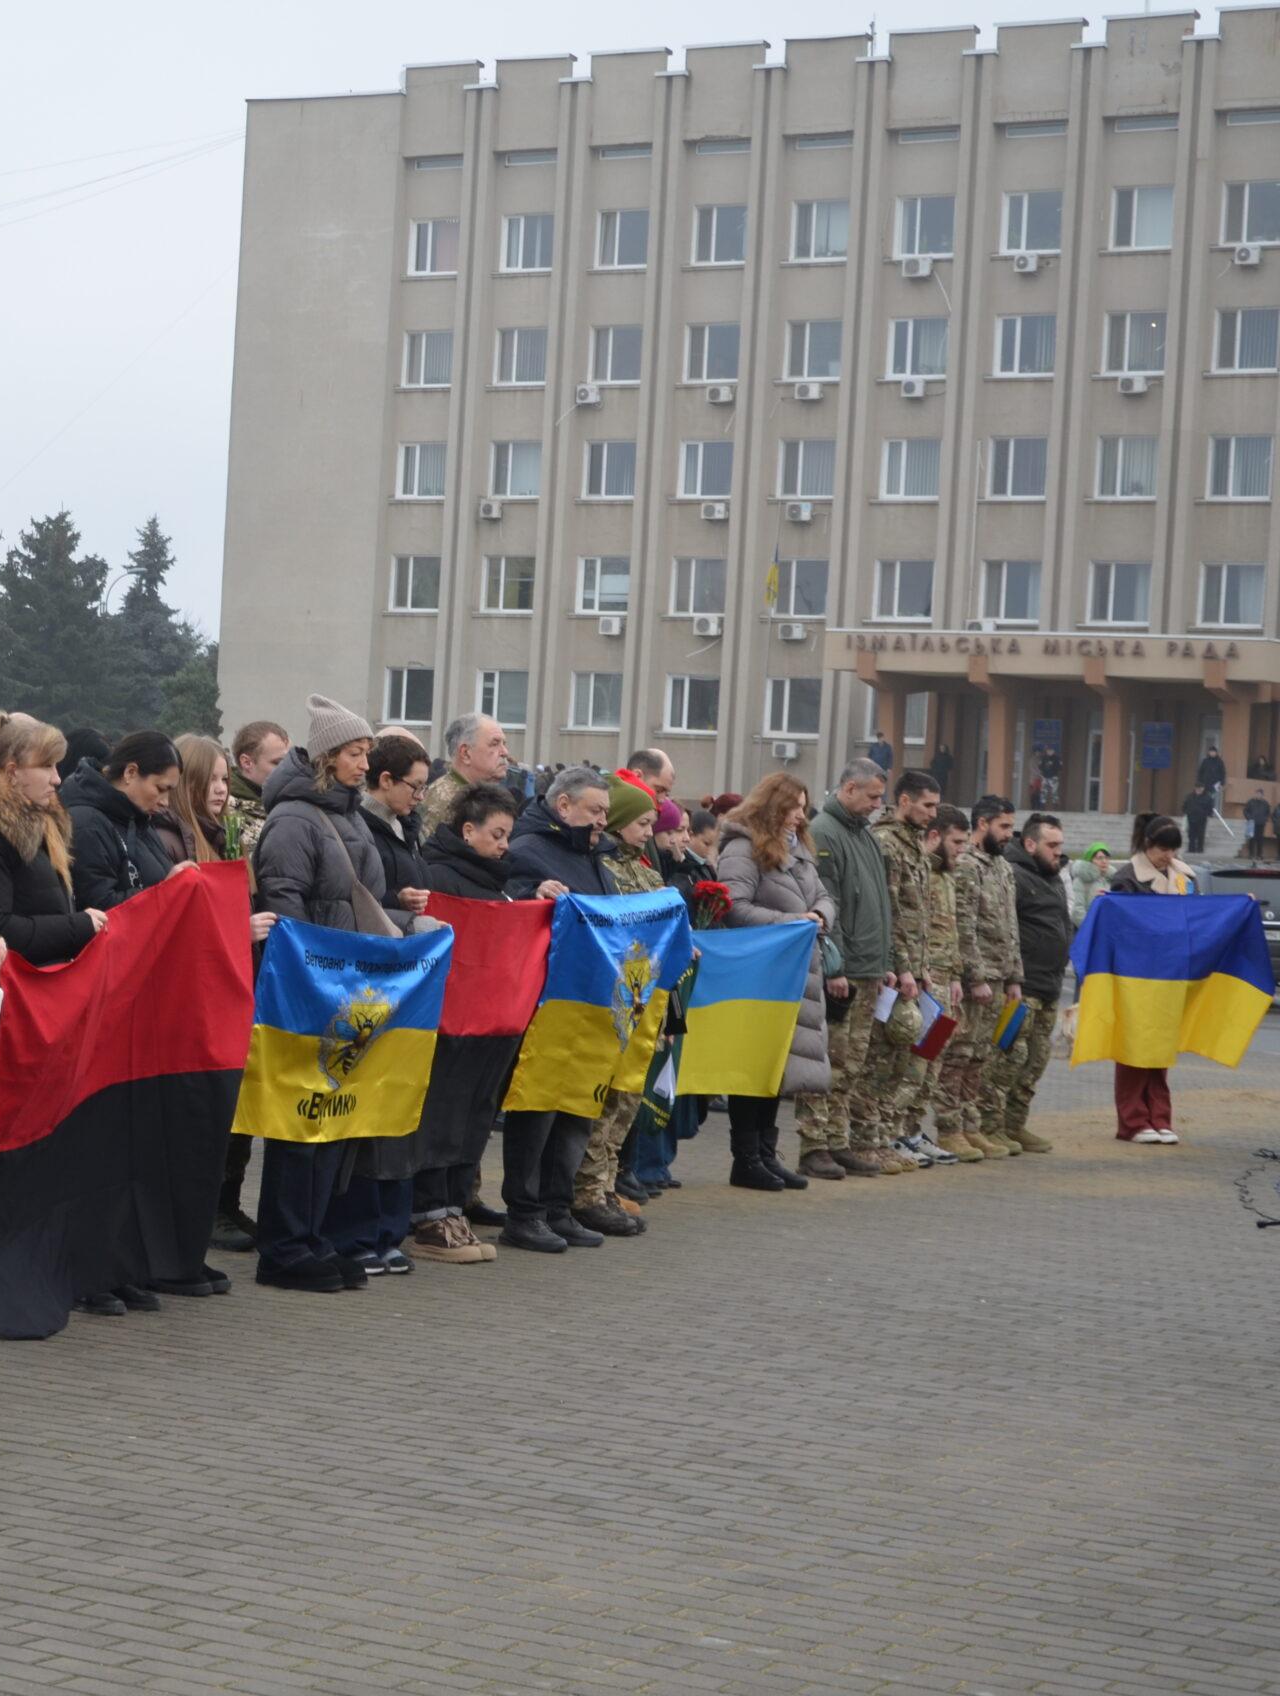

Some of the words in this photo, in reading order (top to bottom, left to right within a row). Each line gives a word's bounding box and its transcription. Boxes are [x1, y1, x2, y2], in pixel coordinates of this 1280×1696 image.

[846, 633, 1022, 655] ІЗМАЇЛЬСЬКА
[1043, 638, 1146, 658] МІСЬКА
[1166, 640, 1240, 661] РАДА
